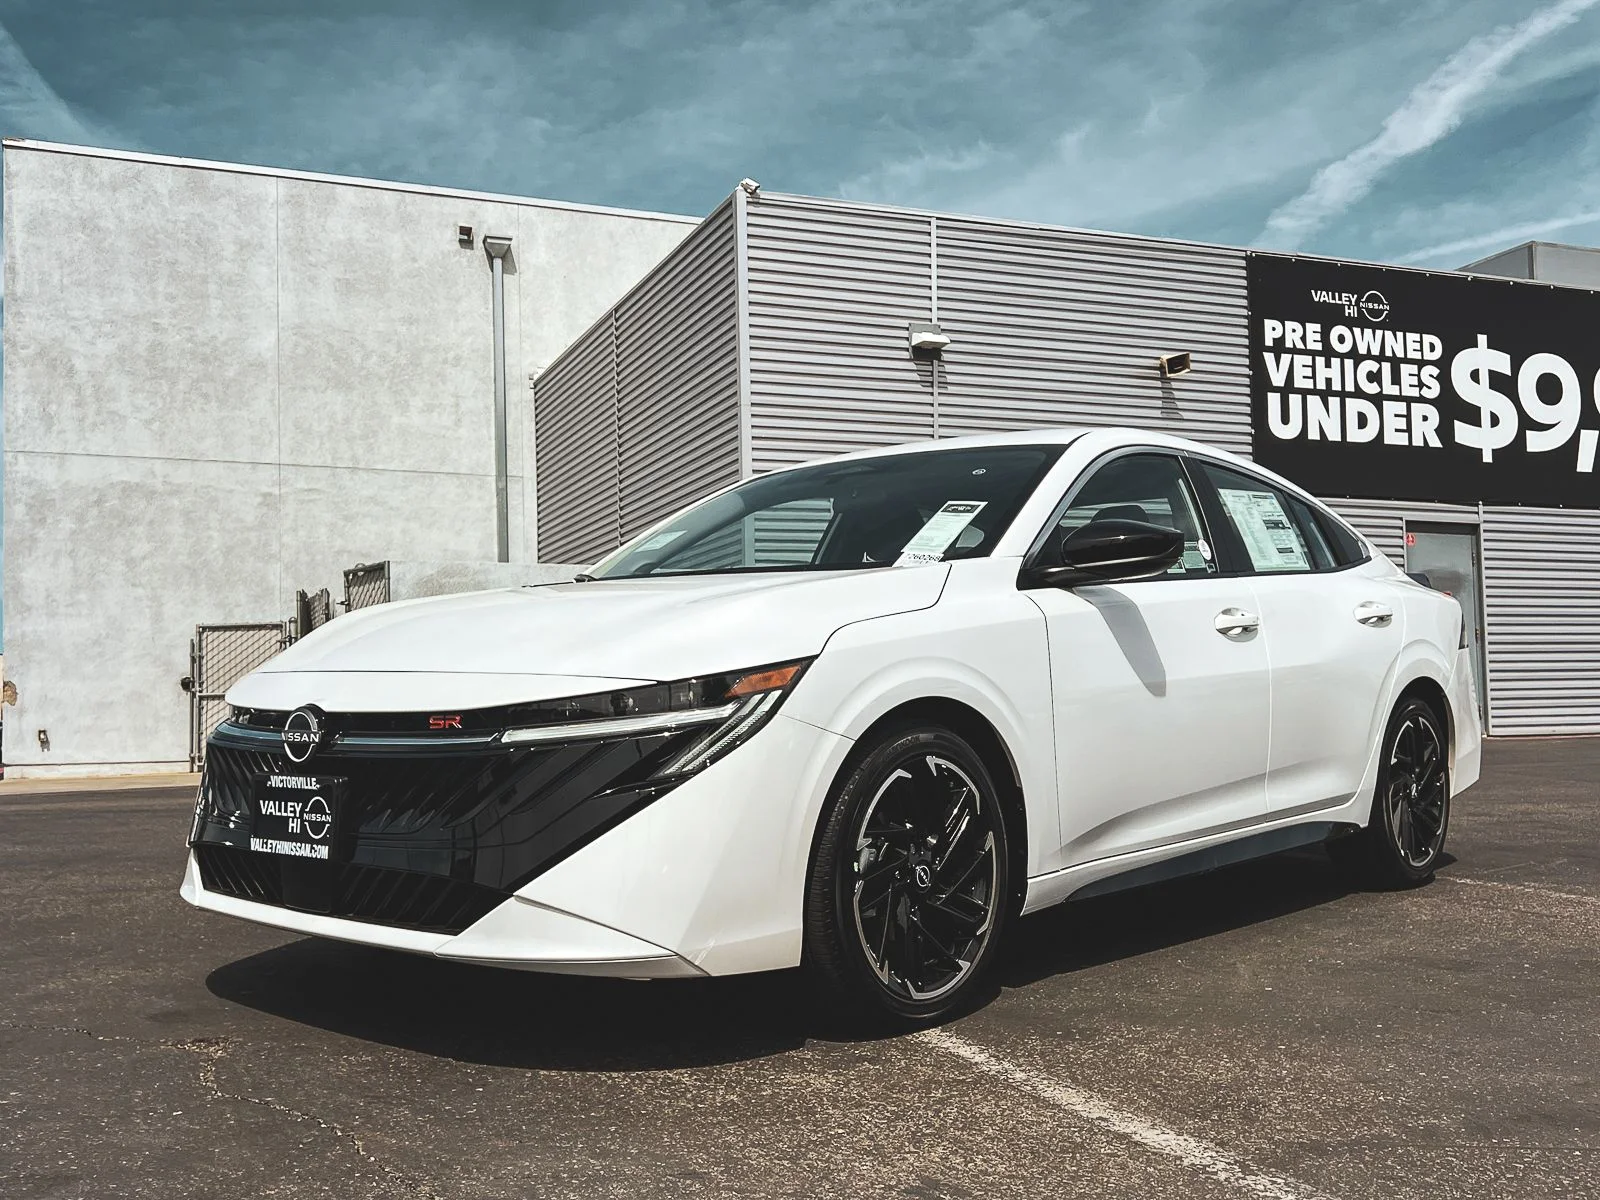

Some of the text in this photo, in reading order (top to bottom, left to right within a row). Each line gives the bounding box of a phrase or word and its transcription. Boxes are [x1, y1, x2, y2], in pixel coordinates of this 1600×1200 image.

[1311, 289, 1357, 305] VALLEY
[1345, 305, 1357, 317] HI
[1360, 302, 1389, 310] NISSAN
[1264, 318, 1443, 361] PRE OWNED
[1263, 351, 1441, 399] VEHICLES
[1450, 333, 1600, 473] $9,
[1267, 392, 1443, 448] UNDER
[429, 715, 462, 728] SR
[270, 775, 317, 789] VICTORVILLE
[260, 800, 302, 817] VALLEY
[288, 818, 300, 833] HI
[303, 813, 331, 822] NISSAN
[250, 837, 329, 859] VALLEYHINISSAN.COM
